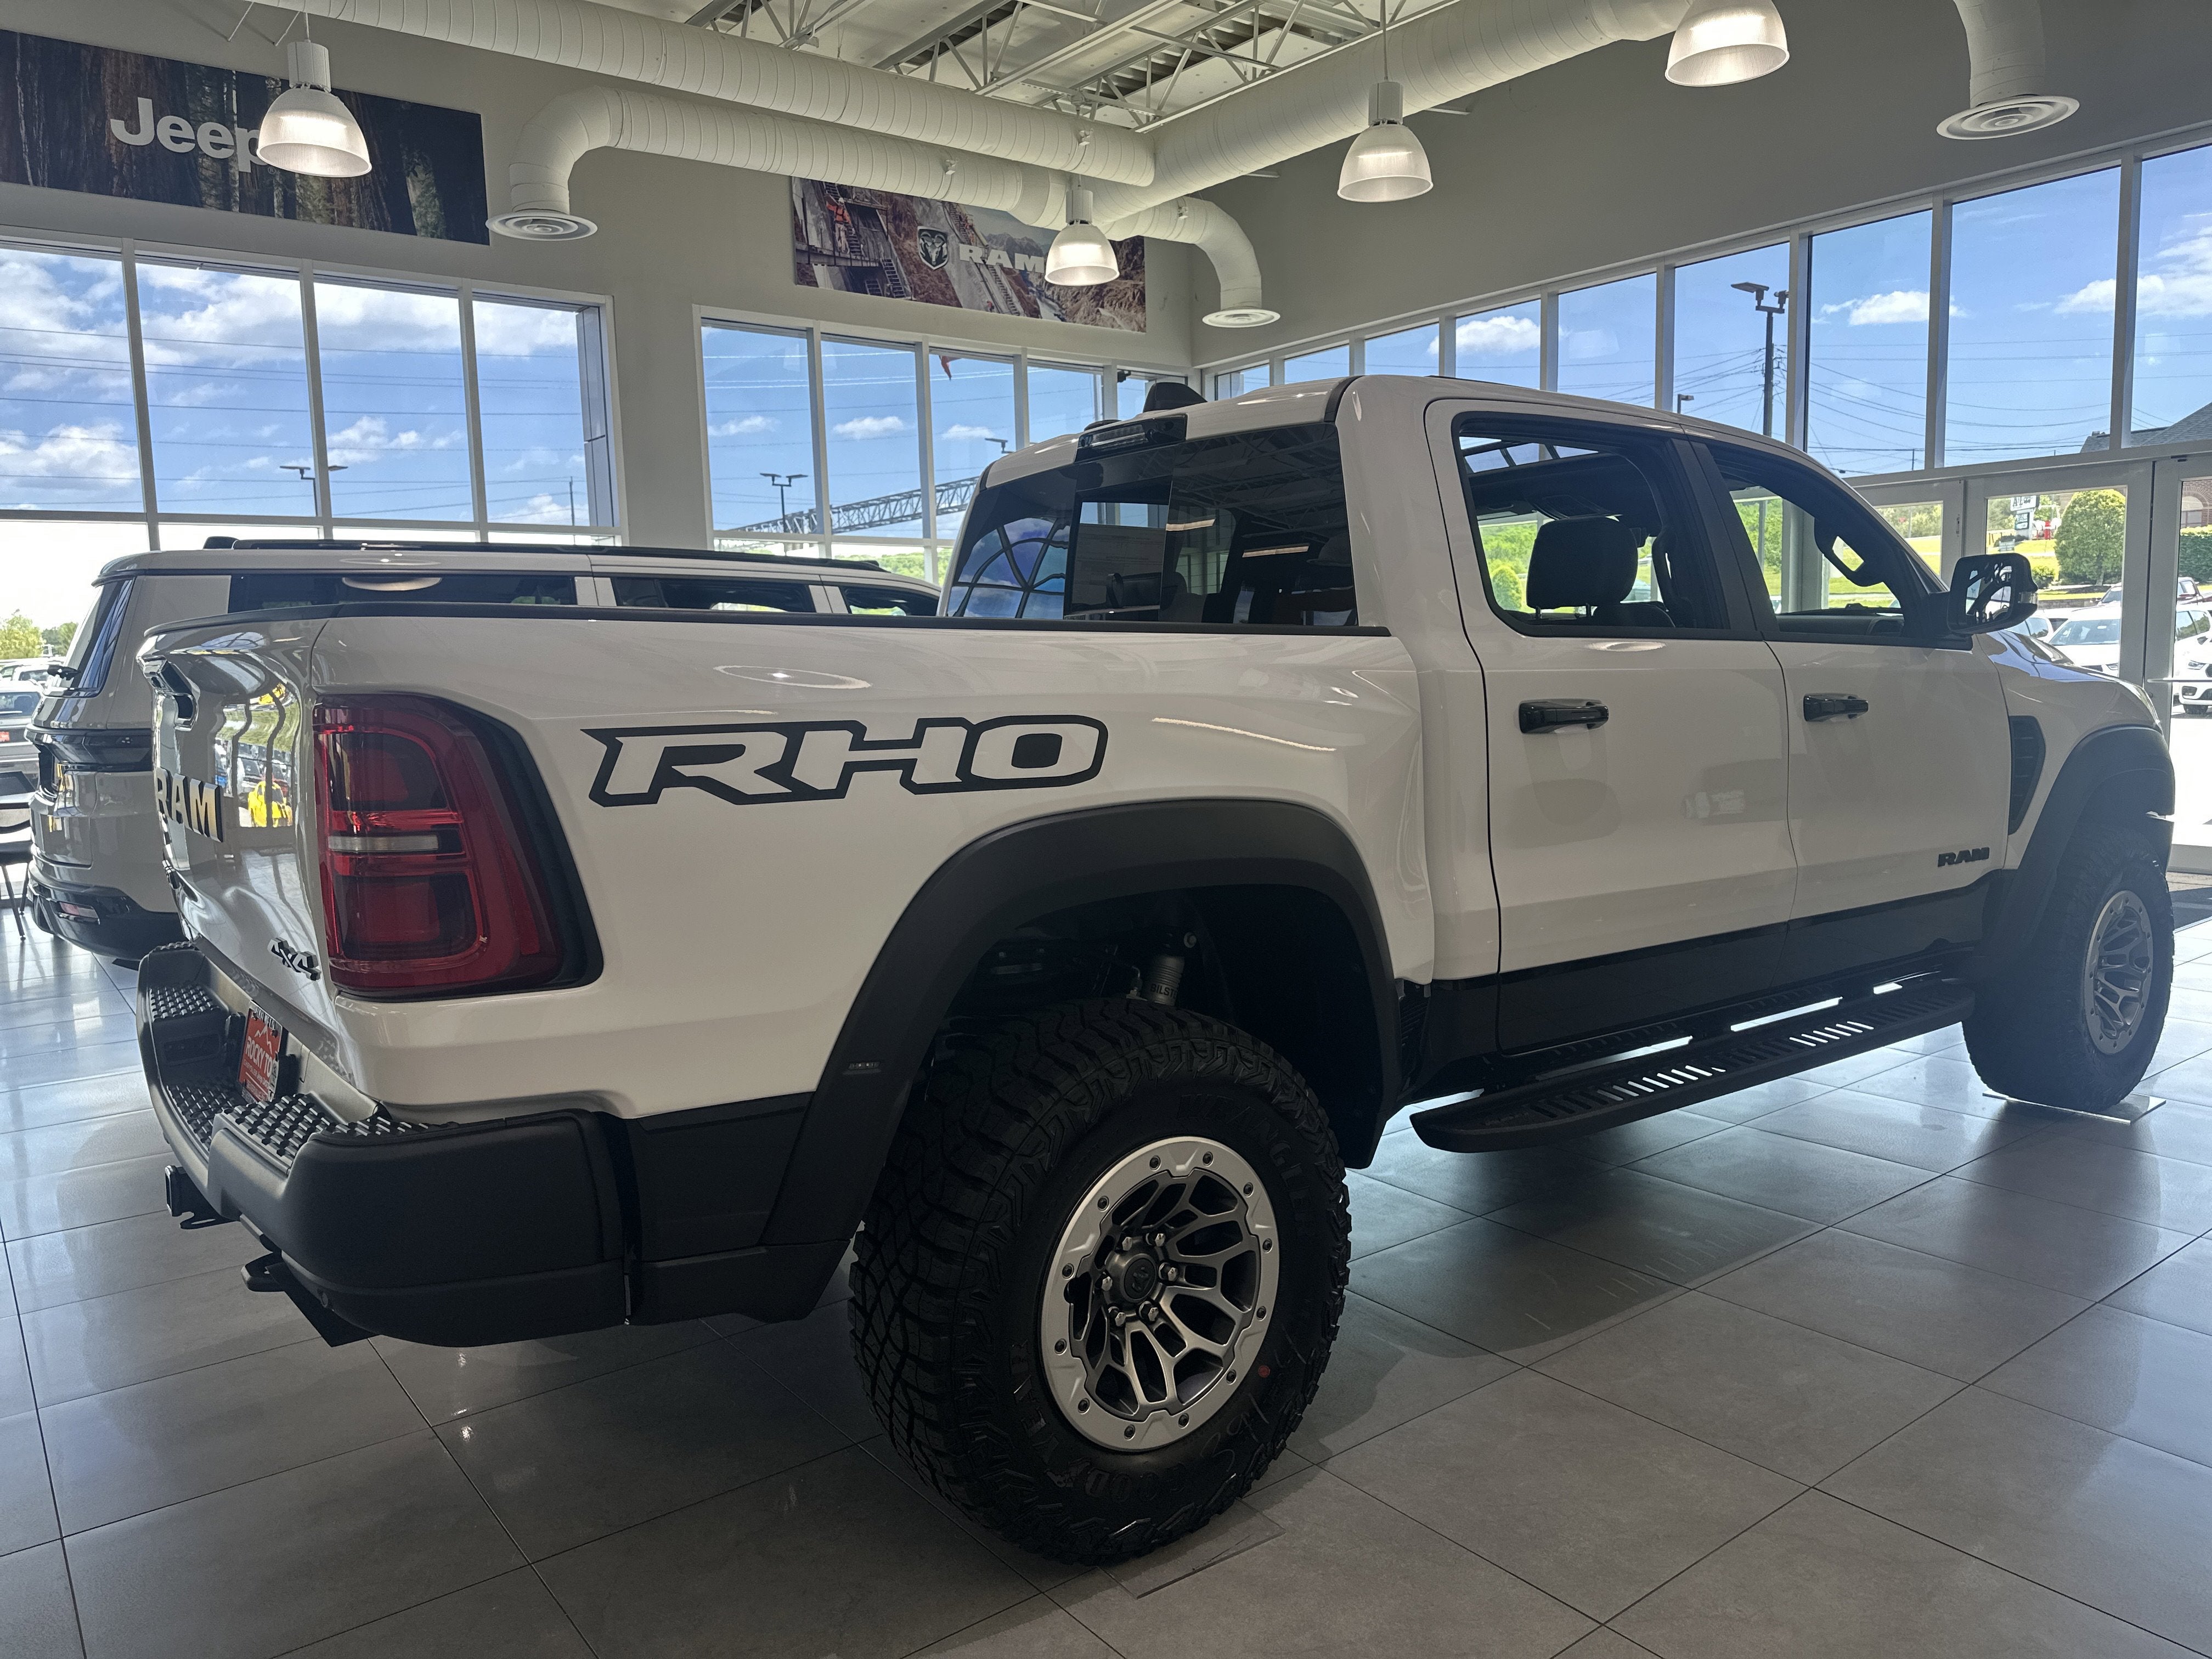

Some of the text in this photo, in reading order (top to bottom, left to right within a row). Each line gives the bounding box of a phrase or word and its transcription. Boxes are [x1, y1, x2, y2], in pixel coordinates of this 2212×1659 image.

[110, 97, 268, 173] Jeep
[959, 244, 1045, 273] RAM
[580, 714, 1109, 808] RHO
[155, 766, 224, 843] RAM
[1937, 847, 1990, 867] RAM
[245, 1035, 265, 1069] ROCKY
[263, 1053, 273, 1079] TO
